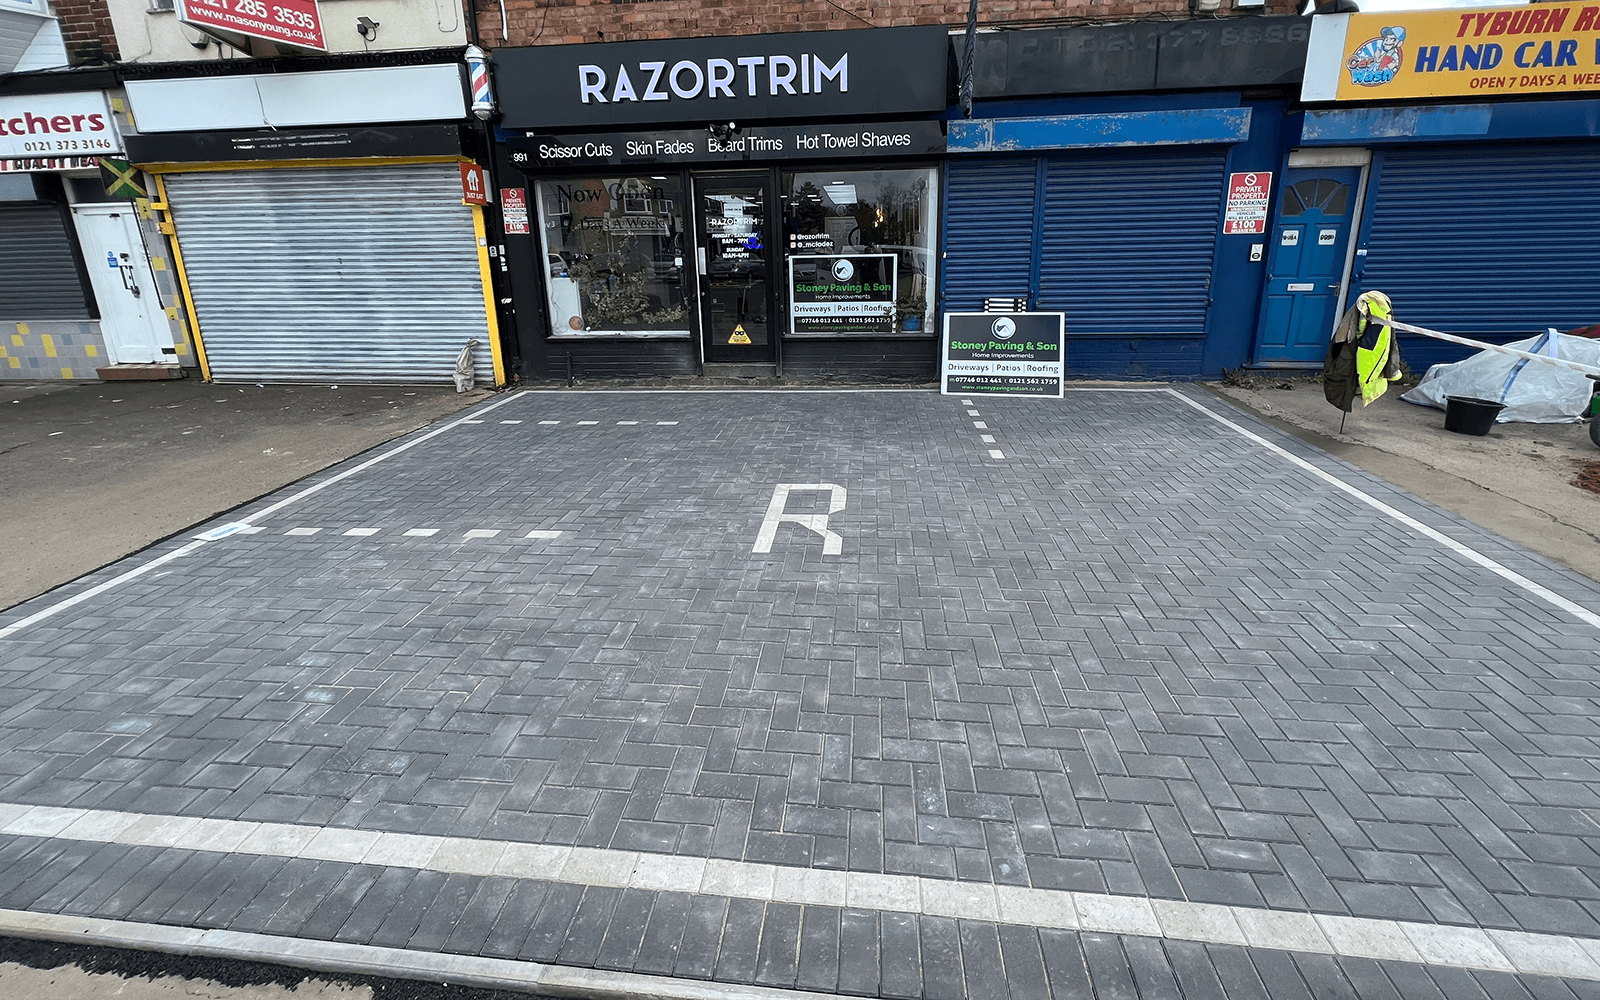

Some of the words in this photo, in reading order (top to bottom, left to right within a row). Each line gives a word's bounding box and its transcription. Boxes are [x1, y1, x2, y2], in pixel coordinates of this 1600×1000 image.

[235, 0, 268, 18] 285
[273, 6, 316, 30] 3535
[190, 6, 317, 41] www.masonyoung.co.uk
[1456, 8, 1571, 38] TYBURN
[1347, 55, 1376, 69] Car
[1414, 43, 1503, 72] HAND
[1514, 39, 1579, 69] CAR
[578, 52, 848, 104] RAZORTRIM
[1351, 69, 1393, 85] Wash
[1470, 77, 1506, 90] OPEN
[1509, 77, 1517, 88] 7
[1519, 75, 1555, 88] DAYS
[1557, 75, 1567, 86] A
[24, 141, 52, 152] 0121
[56, 140, 79, 150] 373
[82, 139, 111, 150] 3146
[513, 152, 527, 161] 991
[539, 144, 582, 158] Scissor
[584, 142, 613, 157] Cuts
[626, 140, 652, 155] Skin
[655, 139, 694, 154] Fades
[747, 136, 783, 151] Trims
[796, 135, 819, 149] Hot
[821, 133, 859, 148] Towel
[861, 131, 911, 147] Shaves
[556, 184, 603, 203] Now
[609, 183, 665, 206] Open
[1231, 192, 1266, 200] PROPERTY
[1235, 185, 1262, 193] PRIVATE
[580, 218, 610, 233] Days
[626, 216, 665, 229] Week
[711, 218, 758, 227] RAZORRIM
[1231, 220, 1256, 229] £100
[797, 232, 830, 241] @razortrim
[796, 284, 829, 293] Stoney
[830, 283, 862, 293] Paving
[863, 283, 871, 291] &
[873, 283, 891, 291] Son
[794, 304, 832, 314] Driveways
[951, 341, 987, 352] Stoney
[988, 341, 1024, 352] Paving
[1025, 341, 1034, 350] &
[1036, 342, 1058, 351] Son
[948, 363, 989, 373] Driveways
[996, 364, 1021, 372] Patios
[1026, 365, 1059, 375] Roofing
[752, 483, 848, 556] R
